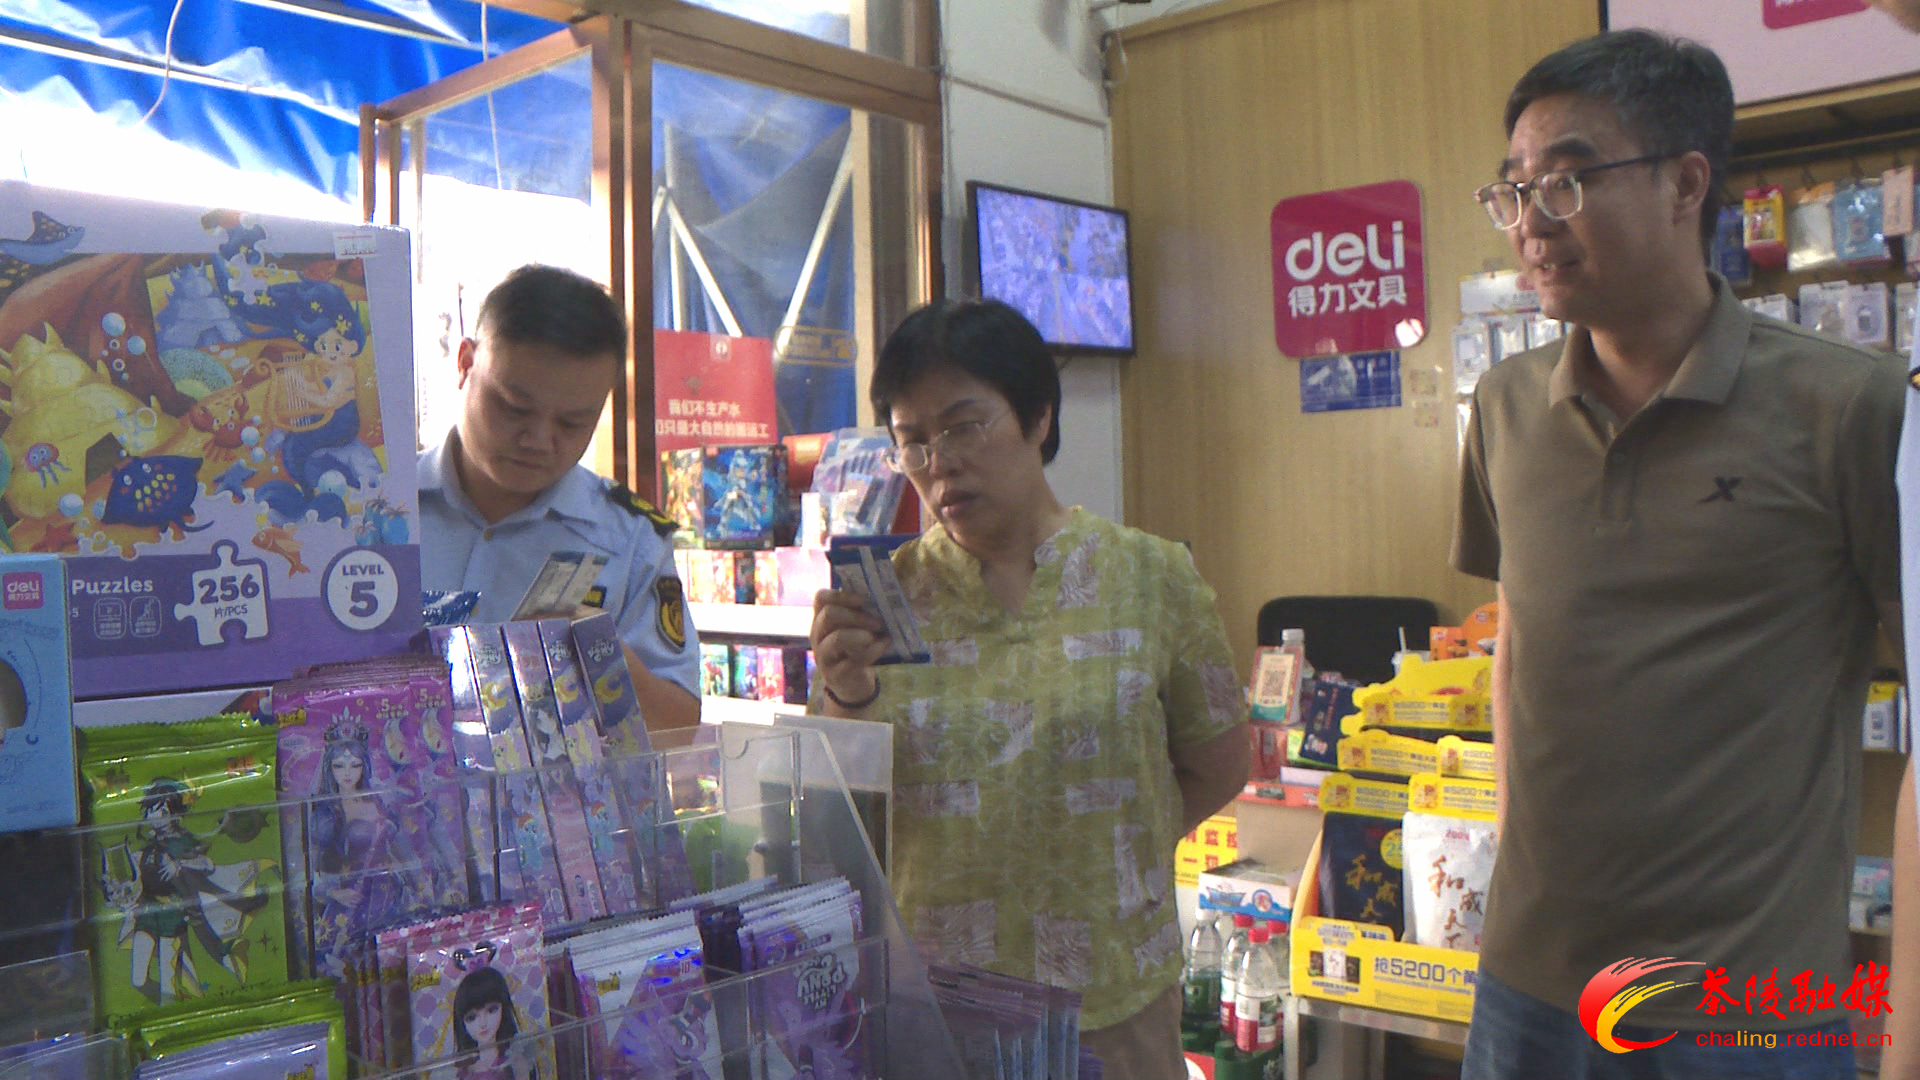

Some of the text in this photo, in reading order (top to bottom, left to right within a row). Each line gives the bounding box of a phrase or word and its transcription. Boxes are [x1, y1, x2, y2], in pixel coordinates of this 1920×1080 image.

[1285, 220, 1405, 281] deli
[1288, 274, 1407, 318] 得力文具
[668, 398, 741, 418] 我们不生产水
[342, 564, 385, 576] LEVEL
[7, 580, 40, 593] deli
[71, 575, 154, 595] Puzzles
[198, 573, 260, 605] 256
[349, 581, 379, 618] 5
